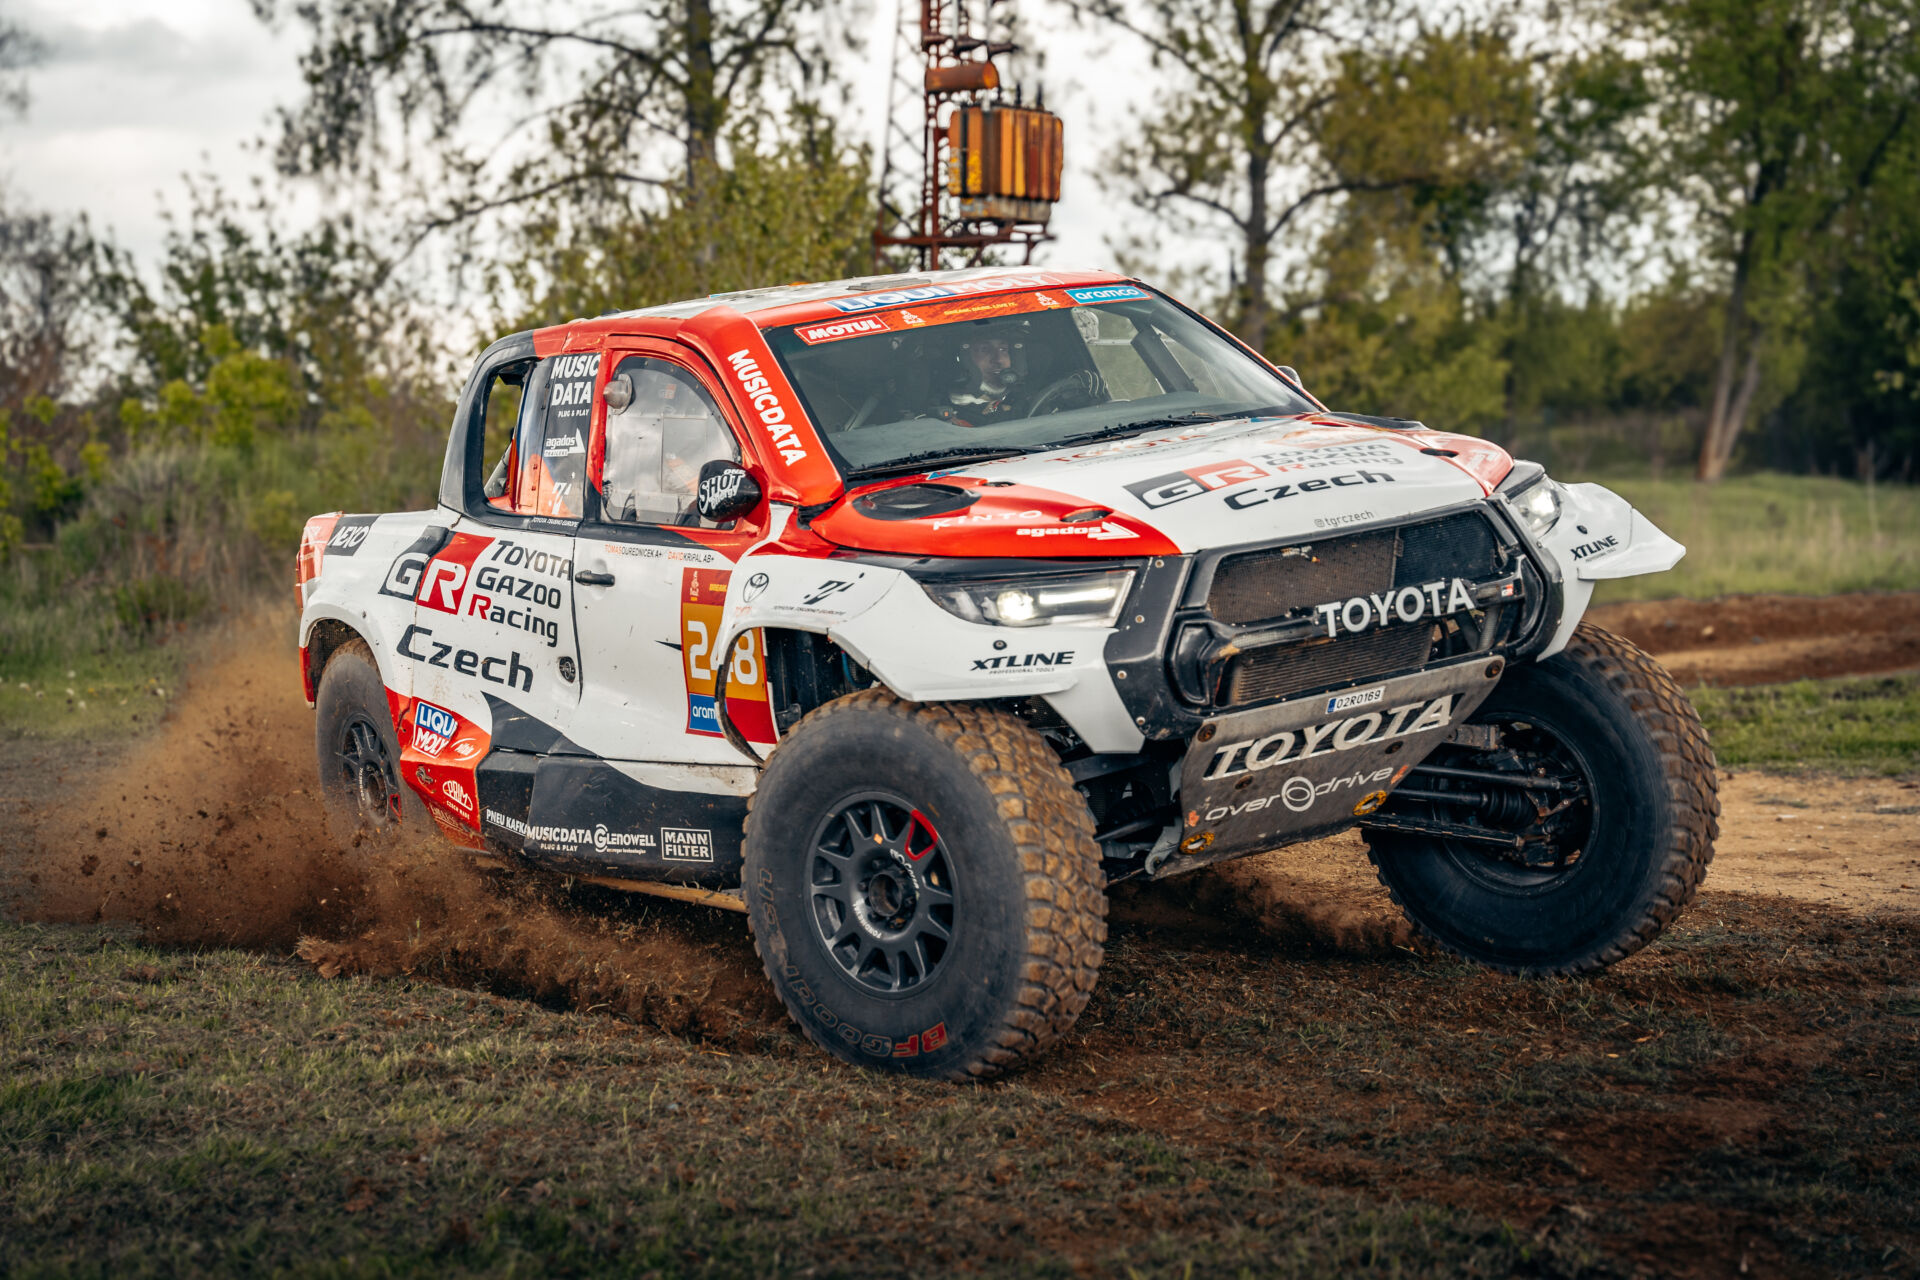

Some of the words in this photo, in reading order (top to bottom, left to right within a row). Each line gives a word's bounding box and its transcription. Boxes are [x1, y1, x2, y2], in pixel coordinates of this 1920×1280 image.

[838, 285, 949, 310] LIQUI
[948, 274, 1044, 294] MOLY
[1075, 287, 1139, 300] aramco
[808, 319, 882, 340] MOTUL
[551, 353, 601, 379] MUSIC
[551, 381, 592, 406] DATA
[558, 409, 571, 418] PLUG
[576, 408, 590, 417] PLAY
[727, 348, 807, 467] MUSICDATA
[545, 434, 576, 450] agados
[1261, 444, 1391, 460] TOYOTA
[1266, 451, 1391, 466] GAZOO
[1276, 457, 1404, 472] Racing
[724, 468, 746, 478] ONE
[699, 473, 742, 514] SHOT
[1142, 465, 1264, 507] GR
[1223, 470, 1396, 511] Czech
[932, 510, 1043, 531] KINTO
[1016, 525, 1102, 538] agados
[1570, 535, 1619, 561] XTLINE
[491, 540, 572, 581] TOYOTA
[385, 551, 468, 610] GR
[475, 566, 562, 610] GAZOO
[1316, 577, 1476, 639] TOYOTA
[468, 593, 559, 648] Racing
[395, 623, 534, 693] Czech
[970, 651, 1076, 671] XTLINE
[1336, 690, 1382, 709] 02R0169
[419, 705, 458, 738] LIQUI
[414, 727, 450, 757] MOLY
[1203, 694, 1454, 780] TOYOTA
[486, 808, 506, 826] PNEU
[526, 825, 593, 845] MUSICDATA
[664, 831, 709, 846] MANN
[540, 842, 556, 851] PLUG
[562, 844, 578, 852] PLAY
[665, 845, 710, 858] FILTER
